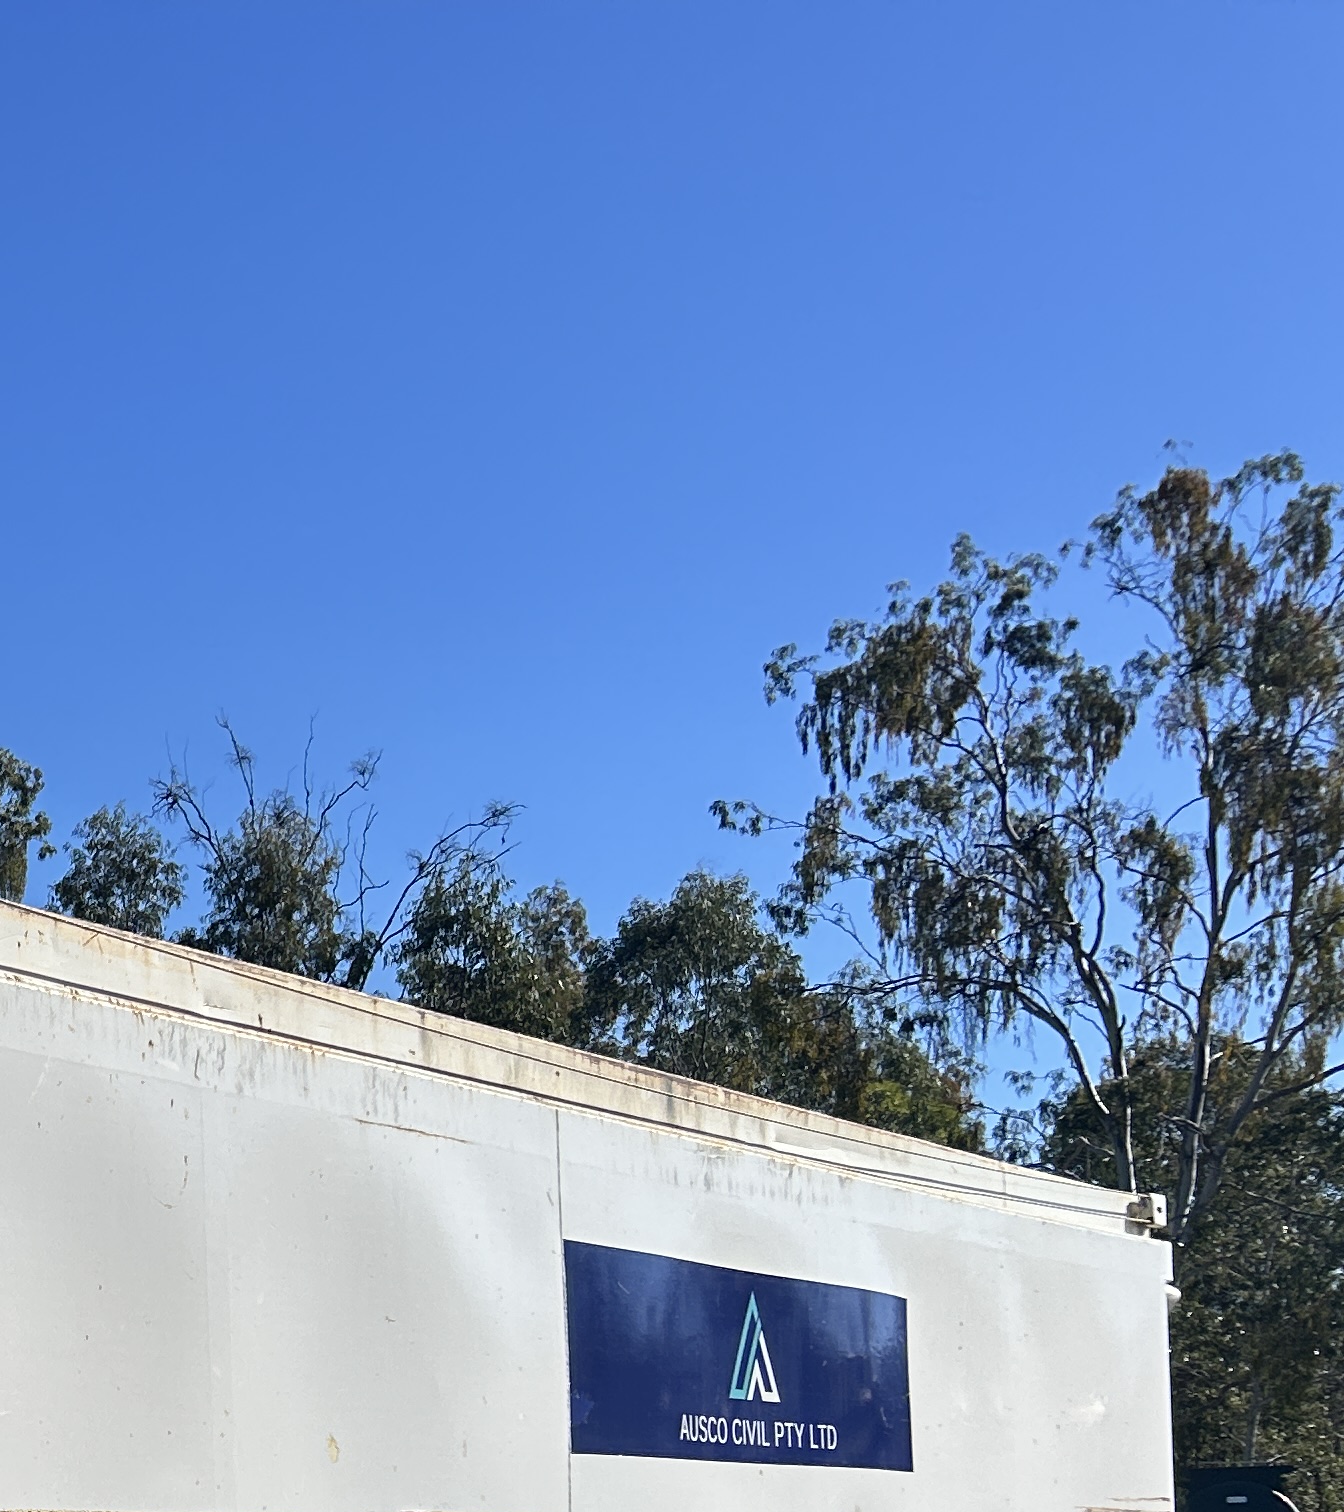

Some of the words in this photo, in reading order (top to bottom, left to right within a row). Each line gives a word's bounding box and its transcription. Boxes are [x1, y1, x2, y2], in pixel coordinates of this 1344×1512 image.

[679, 1413, 729, 1444] AUSCO
[731, 1418, 771, 1447] CIVIL
[774, 1421, 805, 1448] PTY
[808, 1423, 838, 1450] LTD
